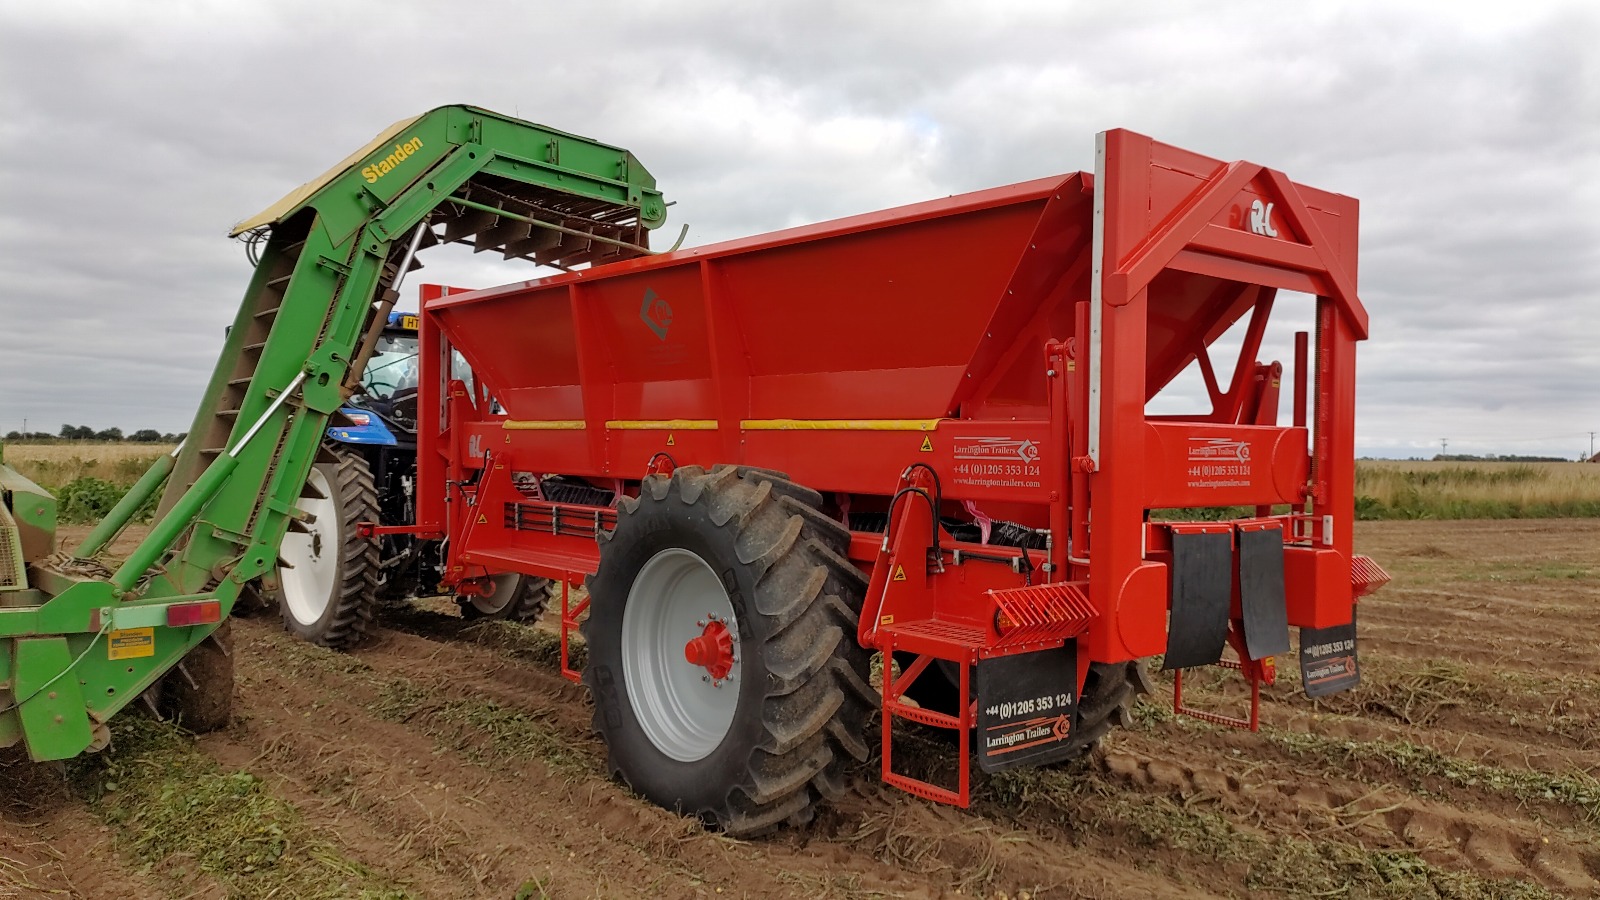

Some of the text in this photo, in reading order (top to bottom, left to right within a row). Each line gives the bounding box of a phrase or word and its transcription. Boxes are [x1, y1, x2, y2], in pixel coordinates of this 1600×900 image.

[361, 137, 424, 184] Standen
[953, 445, 1016, 455] Larrington Trailers
[953, 463, 1040, 476] +44 (0)1205 353 124
[1188, 465, 1250, 477] +44 (0)1205 353 124
[953, 477, 1041, 488] www.larringtontrailers.com
[986, 693, 1072, 720] +44 (0)1205 353 124
[986, 726, 1051, 748] Larrington Trailers
